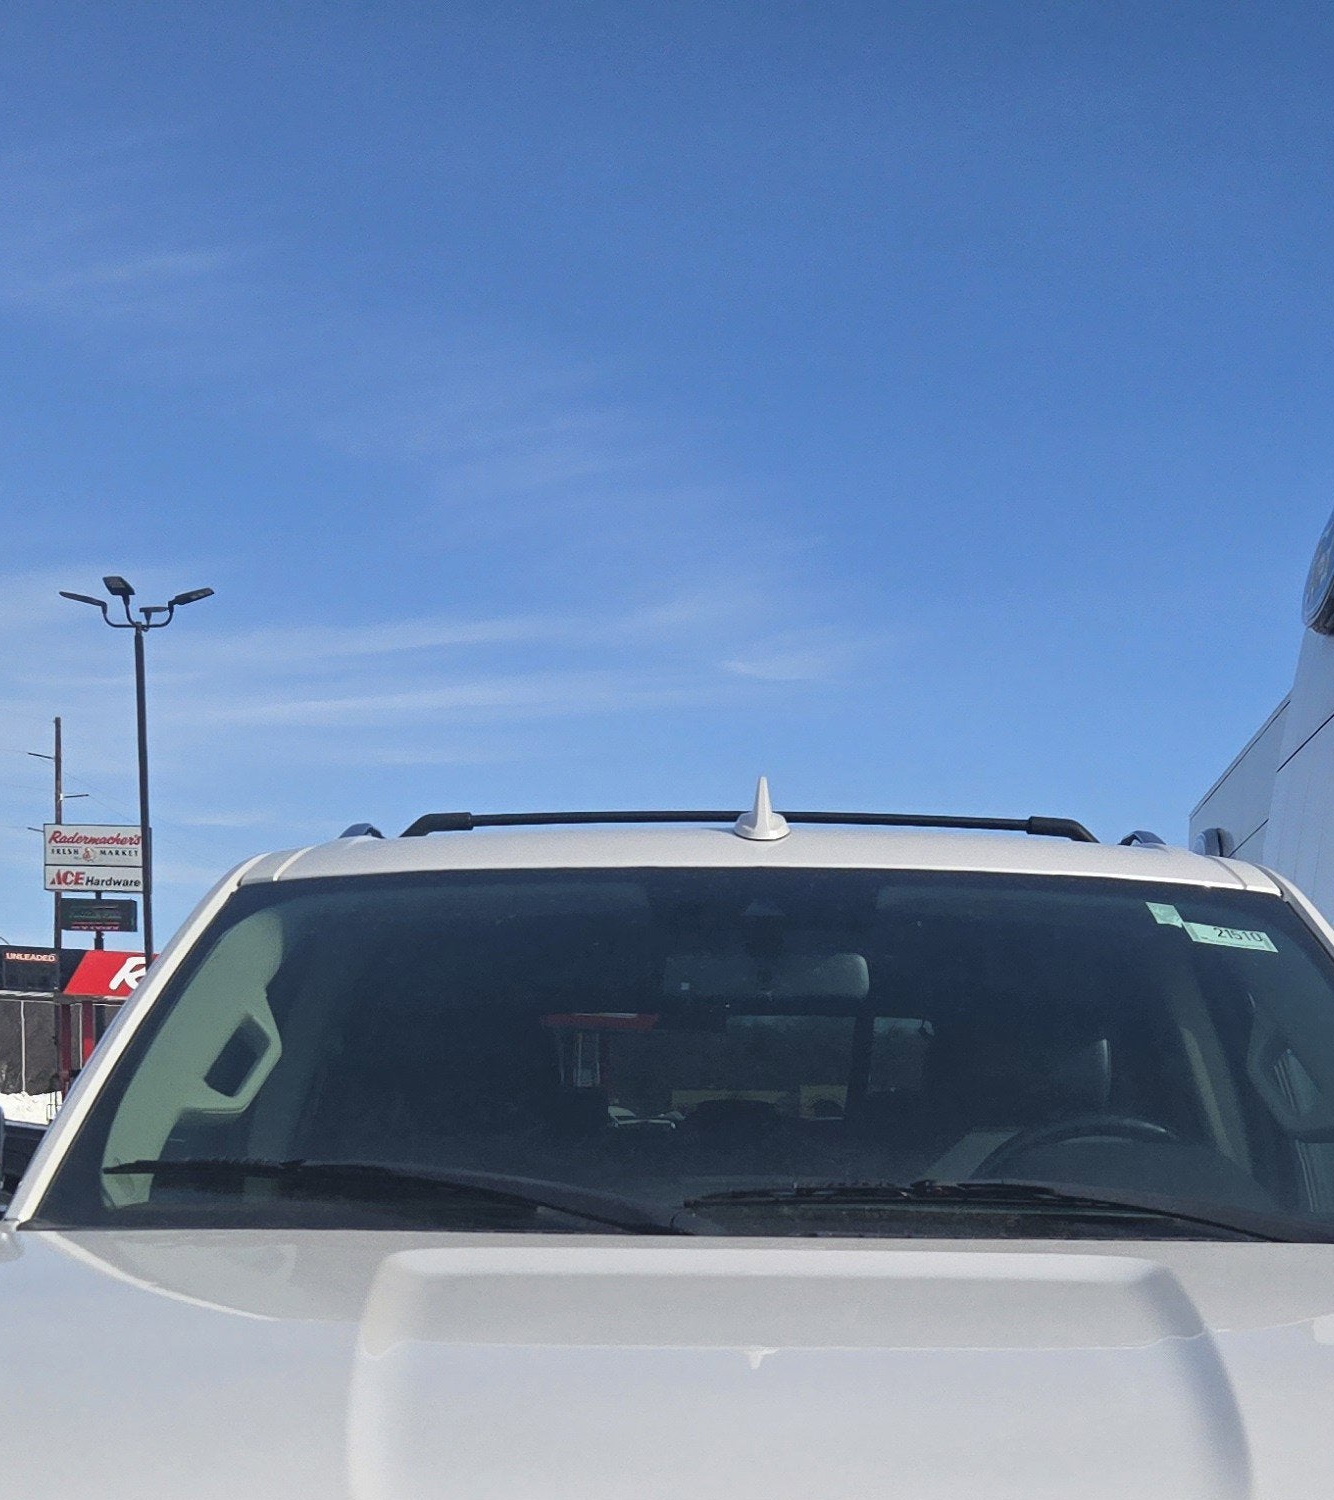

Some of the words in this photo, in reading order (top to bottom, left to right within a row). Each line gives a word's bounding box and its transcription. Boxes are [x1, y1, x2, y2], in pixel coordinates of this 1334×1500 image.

[48, 830, 142, 846] Radermacher's
[99, 849, 138, 857] MARKET
[49, 869, 86, 886] ACE
[85, 876, 141, 887] Hardware
[1213, 926, 1263, 942] 21510
[5, 952, 55, 962] UNLEADED
